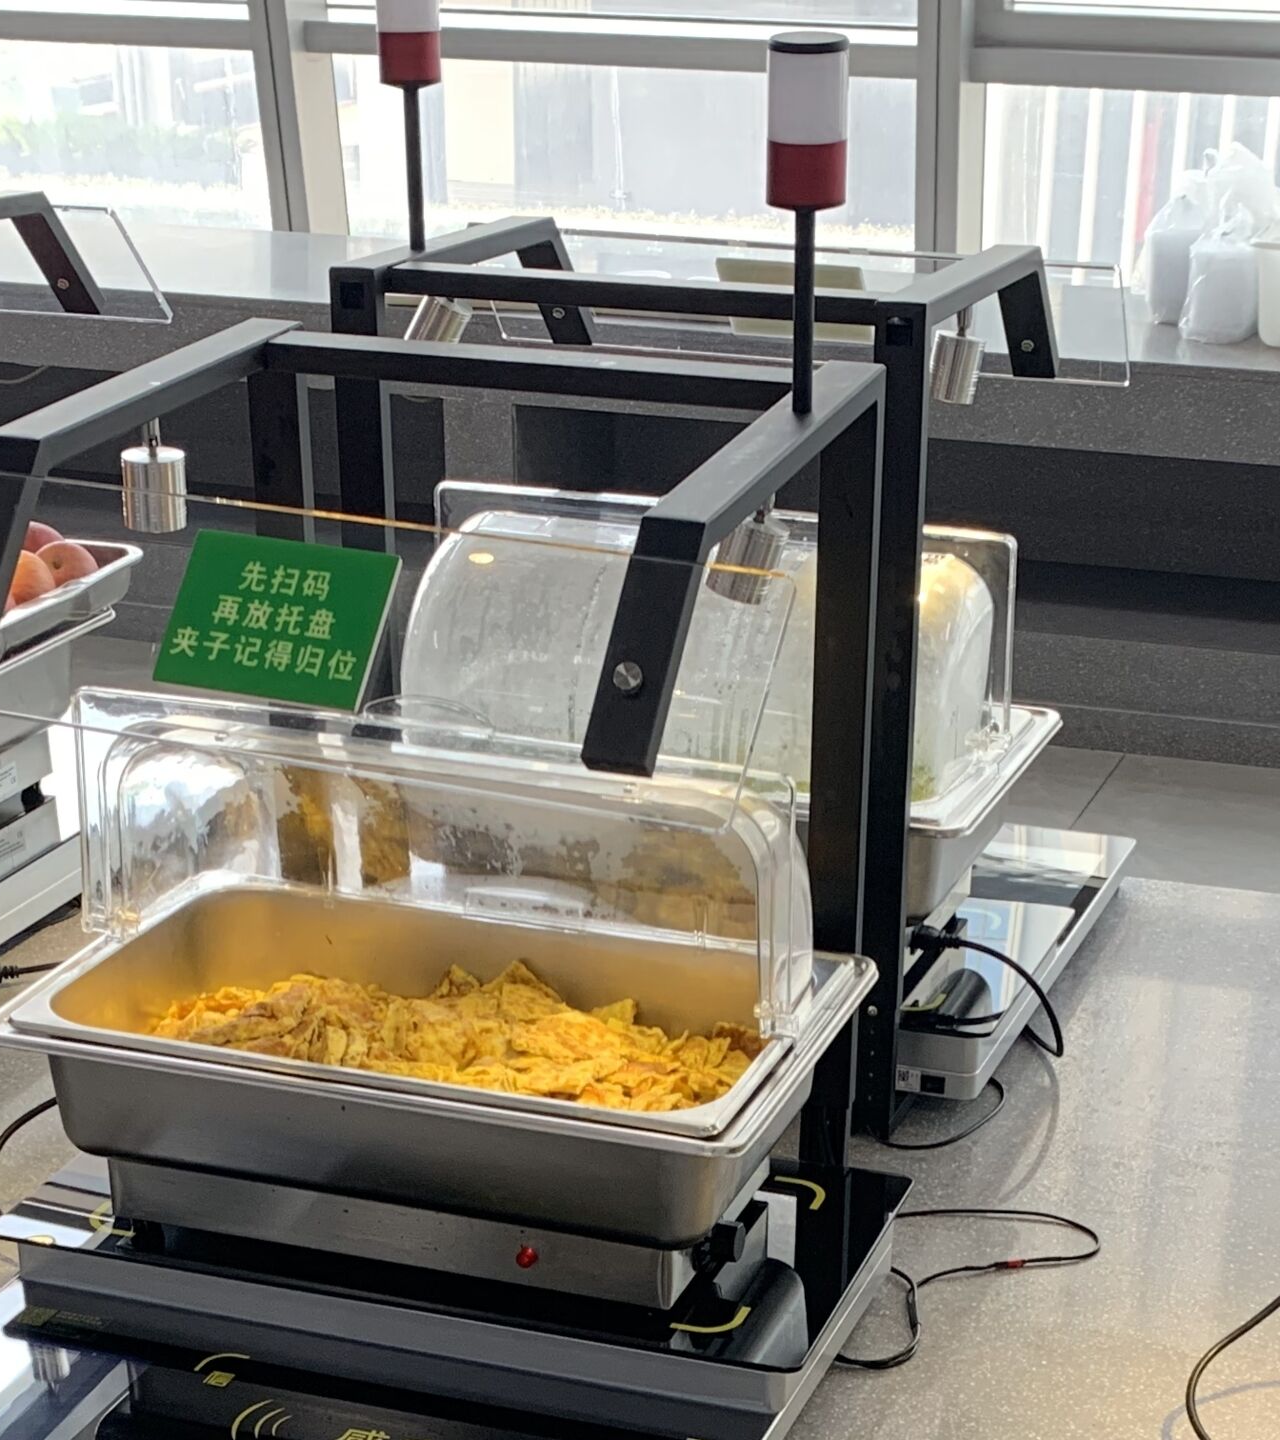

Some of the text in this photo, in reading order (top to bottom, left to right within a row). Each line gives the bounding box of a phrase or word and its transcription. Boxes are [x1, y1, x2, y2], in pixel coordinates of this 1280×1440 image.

[238, 560, 332, 601] 先扫码
[211, 593, 337, 640] 再放托盘
[169, 626, 358, 681] 夹子记得归位
